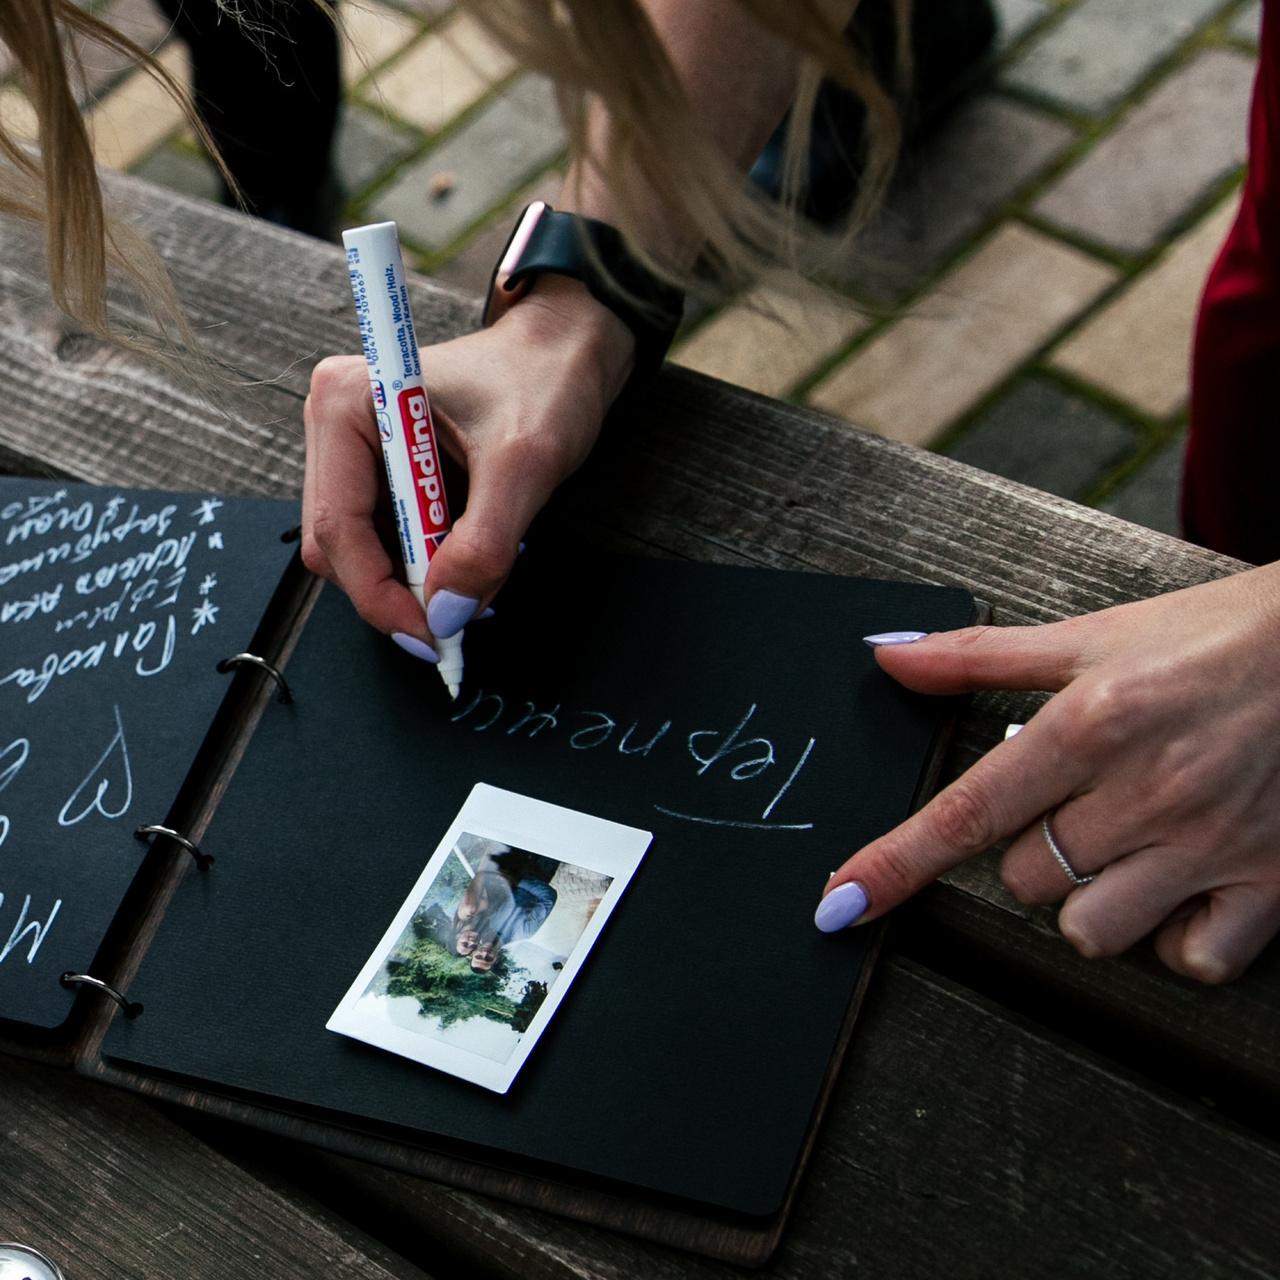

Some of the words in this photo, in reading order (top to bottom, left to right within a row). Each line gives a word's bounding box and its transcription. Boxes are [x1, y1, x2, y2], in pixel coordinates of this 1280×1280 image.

[385, 263, 402, 324] Wood/Holz,
[397, 324, 413, 379] Terracotta,
[407, 395, 445, 526] edding
[399, 498, 416, 565] www.edding.com
